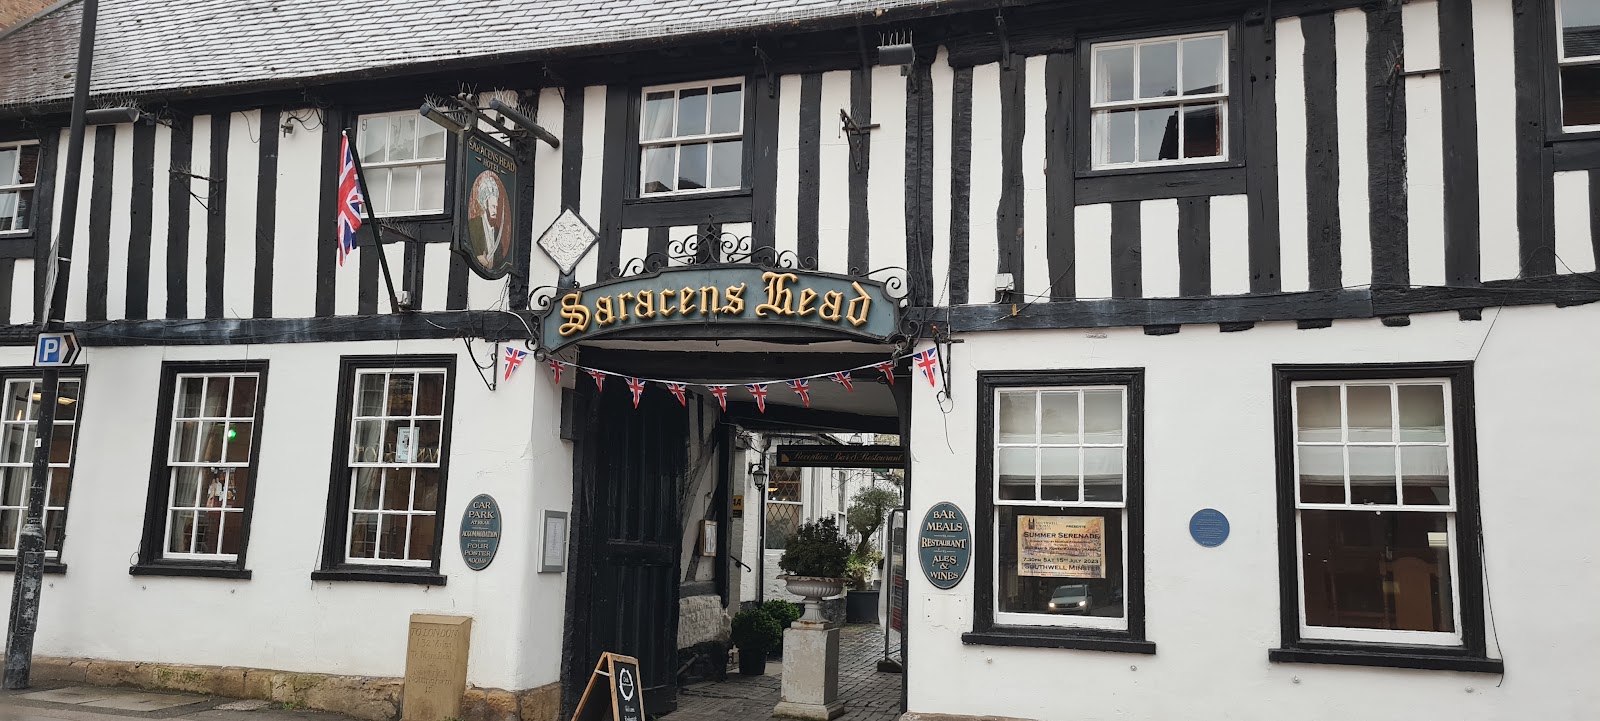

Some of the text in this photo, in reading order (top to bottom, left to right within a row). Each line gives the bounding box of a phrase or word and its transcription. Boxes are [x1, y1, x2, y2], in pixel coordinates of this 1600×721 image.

[468, 139, 515, 173] SARACENS HEAD
[483, 158, 500, 174] HOTEL
[558, 271, 872, 337] Saracens Head
[43, 338, 58, 362] P
[472, 501, 491, 509] CAR
[468, 510, 495, 519] PARK
[933, 509, 956, 519] BAR
[926, 522, 963, 532] MEALS
[1057, 531, 1100, 540] SERENADE
[921, 536, 967, 549] RESTAURANT
[933, 555, 957, 565] ALES
[940, 562, 949, 570] &
[1024, 563, 1101, 572] SOUTHWELL MINSTER
[930, 571, 959, 580] WINES
[411, 627, 460, 638] TO LONDON
